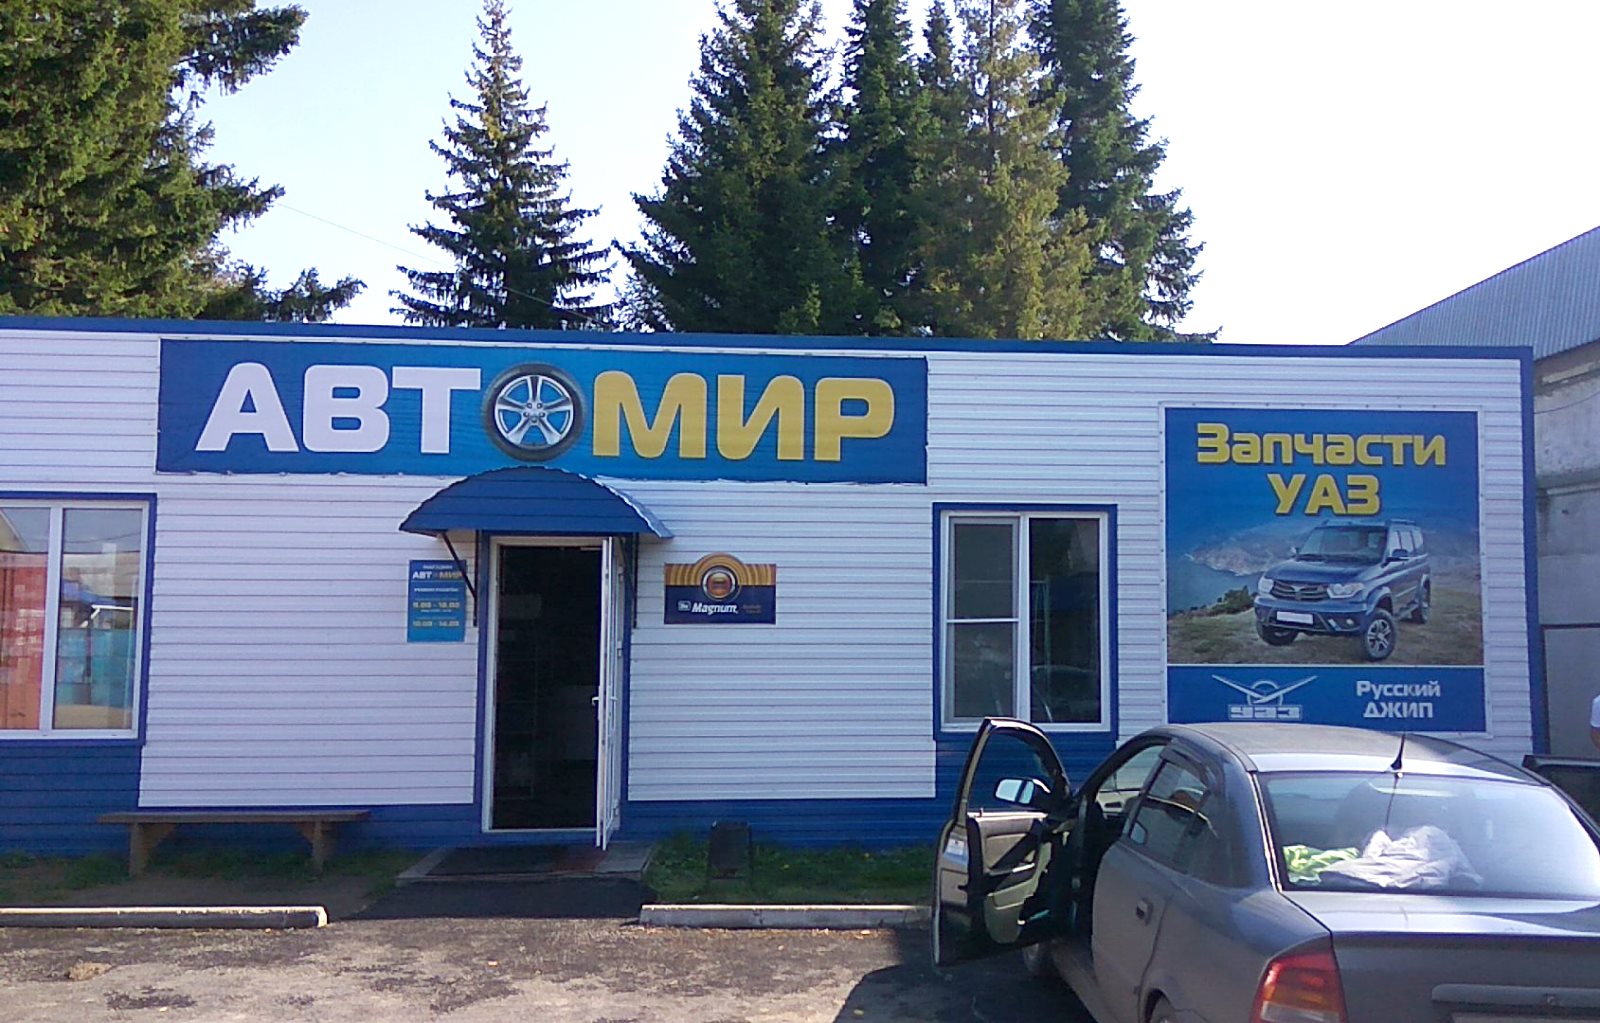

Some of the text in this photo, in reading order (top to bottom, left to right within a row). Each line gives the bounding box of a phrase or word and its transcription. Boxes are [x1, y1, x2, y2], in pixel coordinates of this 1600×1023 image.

[1196, 422, 1447, 466] Запчасти
[1266, 473, 1381, 515] УАЗ
[691, 602, 739, 616] Magnum
[1355, 680, 1441, 700] Русский
[1362, 701, 1434, 719] ДЖИП
